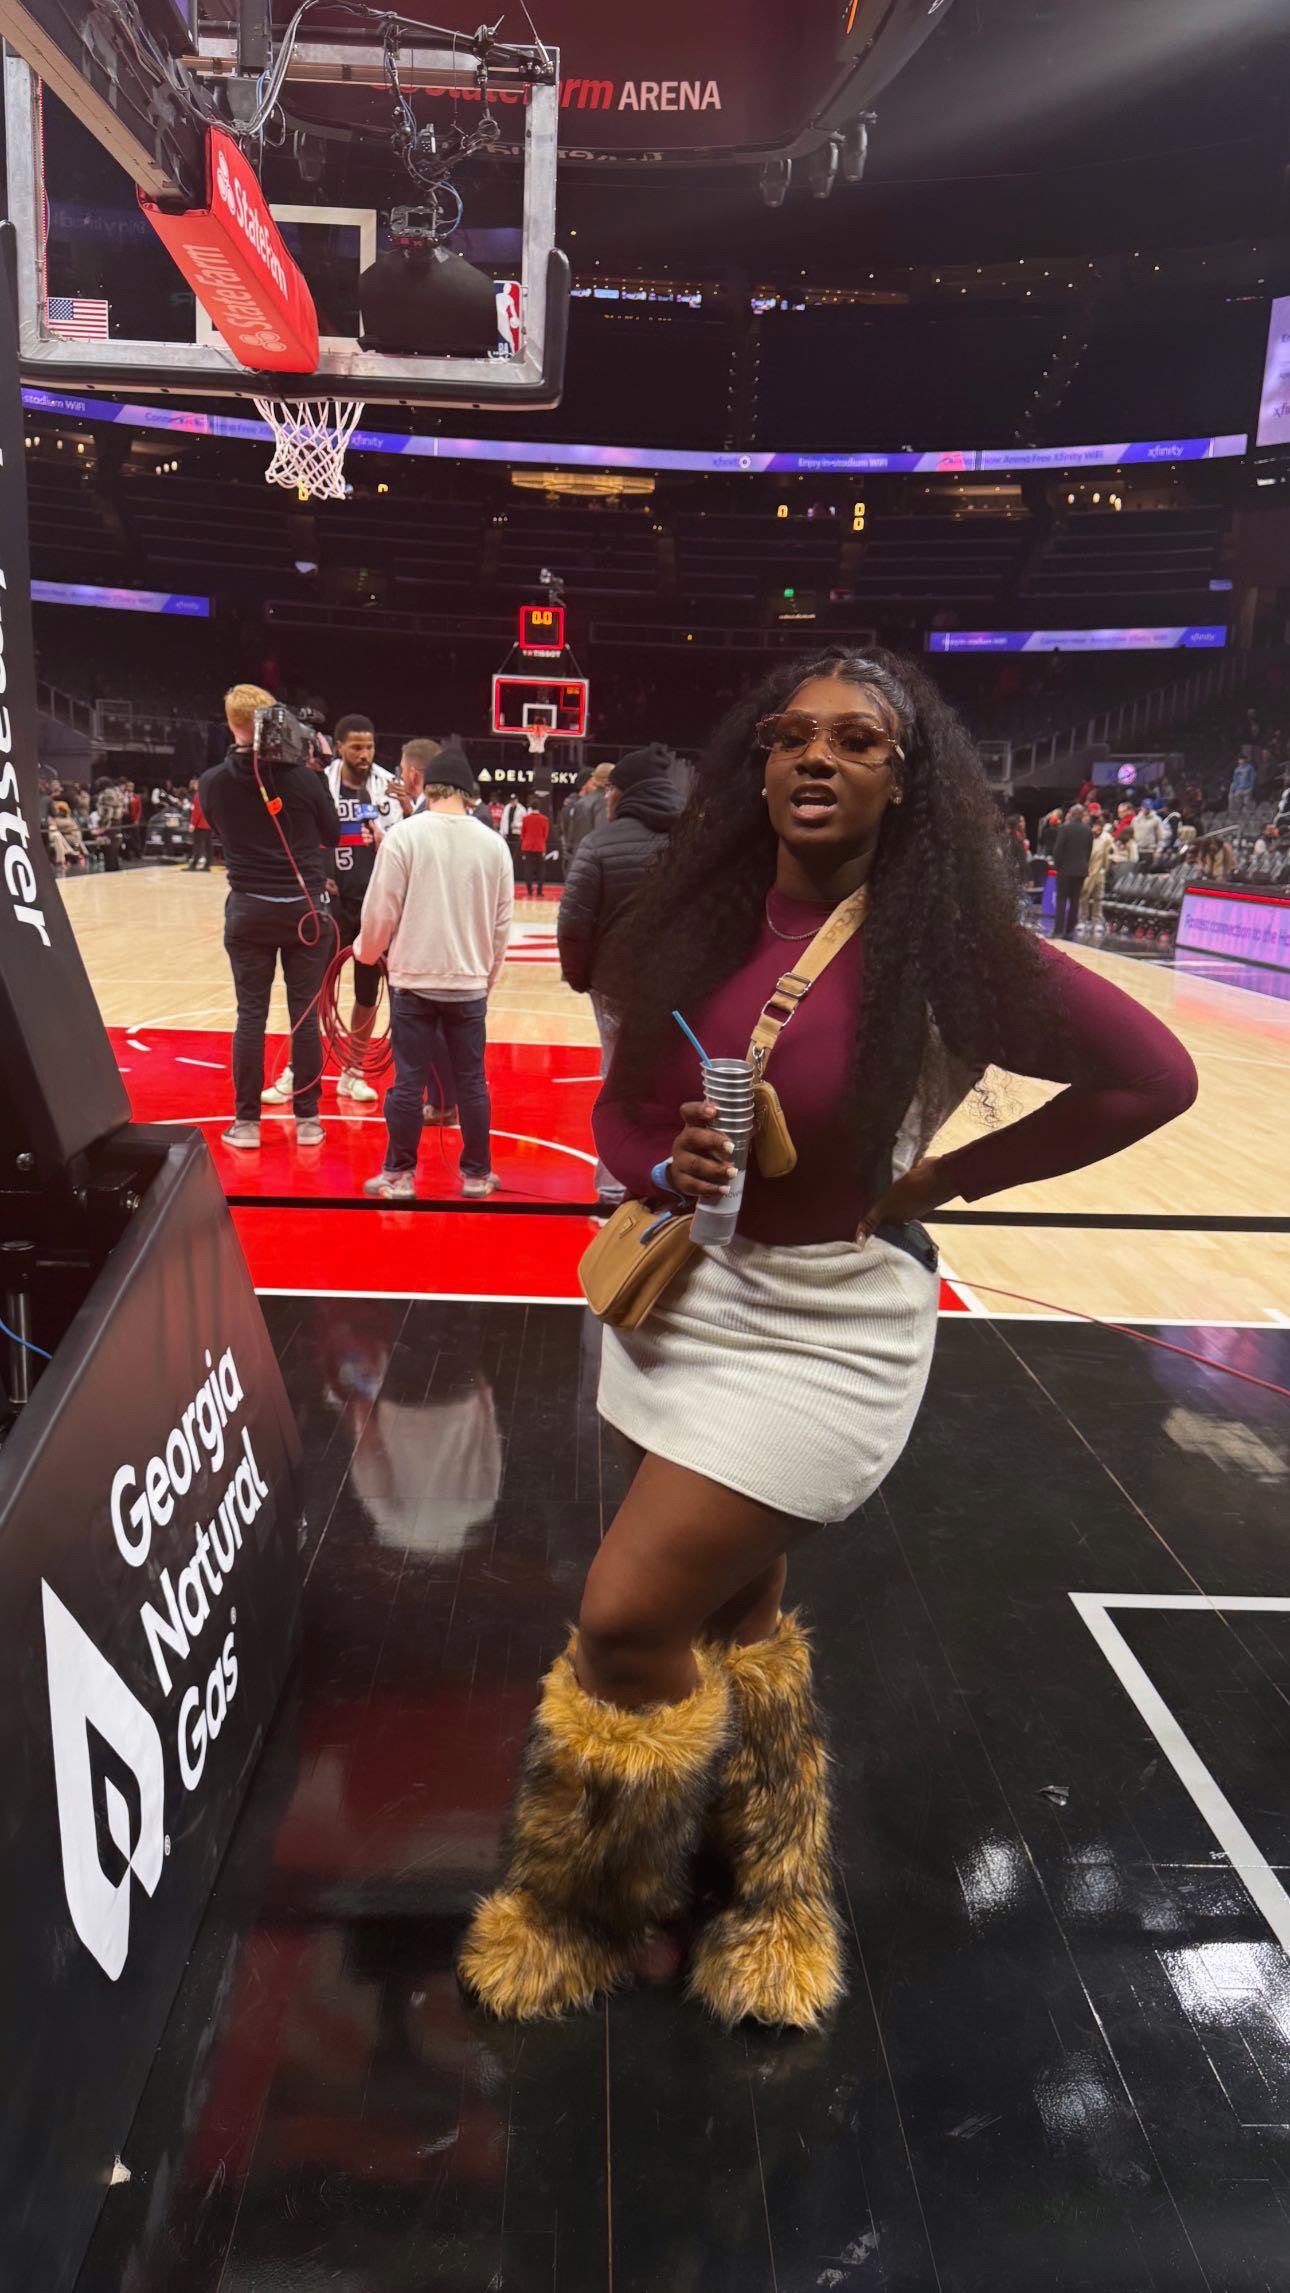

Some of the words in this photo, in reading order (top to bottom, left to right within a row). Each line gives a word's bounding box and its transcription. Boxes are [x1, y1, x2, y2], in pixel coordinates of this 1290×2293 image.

[617, 80, 722, 111] ARENA
[1147, 444, 1184, 459] xfinity
[494, 768, 534, 782] DELT
[551, 771, 579, 784] SKY
[109, 1344, 245, 1569] Georgia
[139, 1425, 270, 1698] Natural
[177, 1629, 240, 1793] Gas
